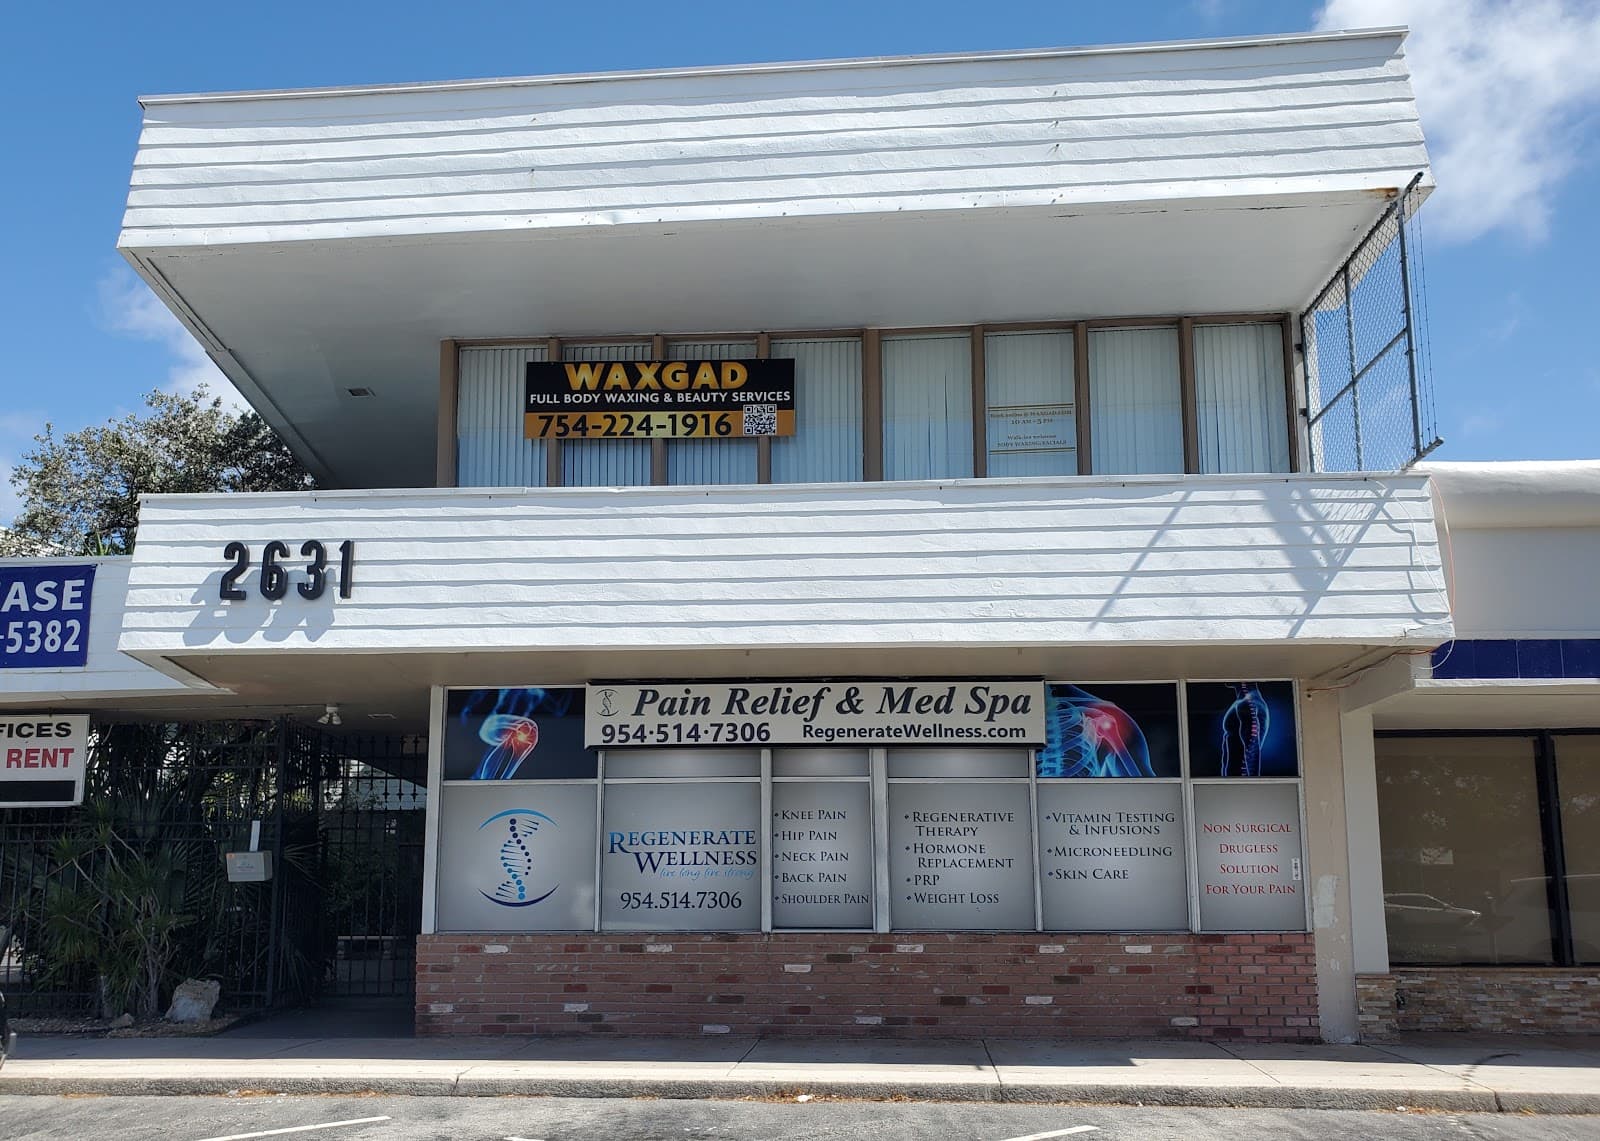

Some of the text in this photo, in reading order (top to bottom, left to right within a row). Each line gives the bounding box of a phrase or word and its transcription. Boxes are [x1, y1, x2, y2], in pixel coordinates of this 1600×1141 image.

[564, 361, 748, 391] WAXGAD
[530, 391, 791, 404] FULL BODY WAXING & BEAUTY SERVICES
[538, 412, 732, 437] 754-224-1916
[219, 540, 355, 601] 2631
[0, 580, 85, 612] ASE
[631, 686, 1032, 723] Pain Relief & Med Spa
[803, 724, 1027, 742] RegenerateWellness.com
[6, 748, 75, 768] RENT
[781, 809, 847, 820] KNEE PAIN
[912, 811, 1015, 823] REGENERATIVE
[1052, 811, 1176, 823] VITAMIN TESTING
[915, 824, 980, 837] THERAPY
[1068, 823, 1160, 836] & INFUSIONS
[1202, 822, 1292, 834] NON SURGICAL
[608, 829, 757, 854] REGENERATE
[781, 830, 837, 841] HIP PAIN
[913, 842, 986, 855] HORMONE
[1054, 845, 1173, 858] MICRONEEDLING
[1219, 842, 1278, 854] DRUGLESS
[634, 850, 758, 874] WELLNESS
[781, 851, 849, 862] NECK PAIN
[917, 856, 1014, 869] REPLACEMENT
[1055, 868, 1129, 880] SKIN CARE
[1219, 863, 1279, 875] SOLUTION
[781, 872, 847, 883] BACK PAIN
[914, 874, 940, 887] PRP
[1206, 884, 1296, 895] FOR YOUR PAIN
[620, 891, 742, 909] 954.514.7306
[781, 894, 869, 905] SHOULDER PAIN
[914, 892, 1000, 905] WEIGHT LOSS
